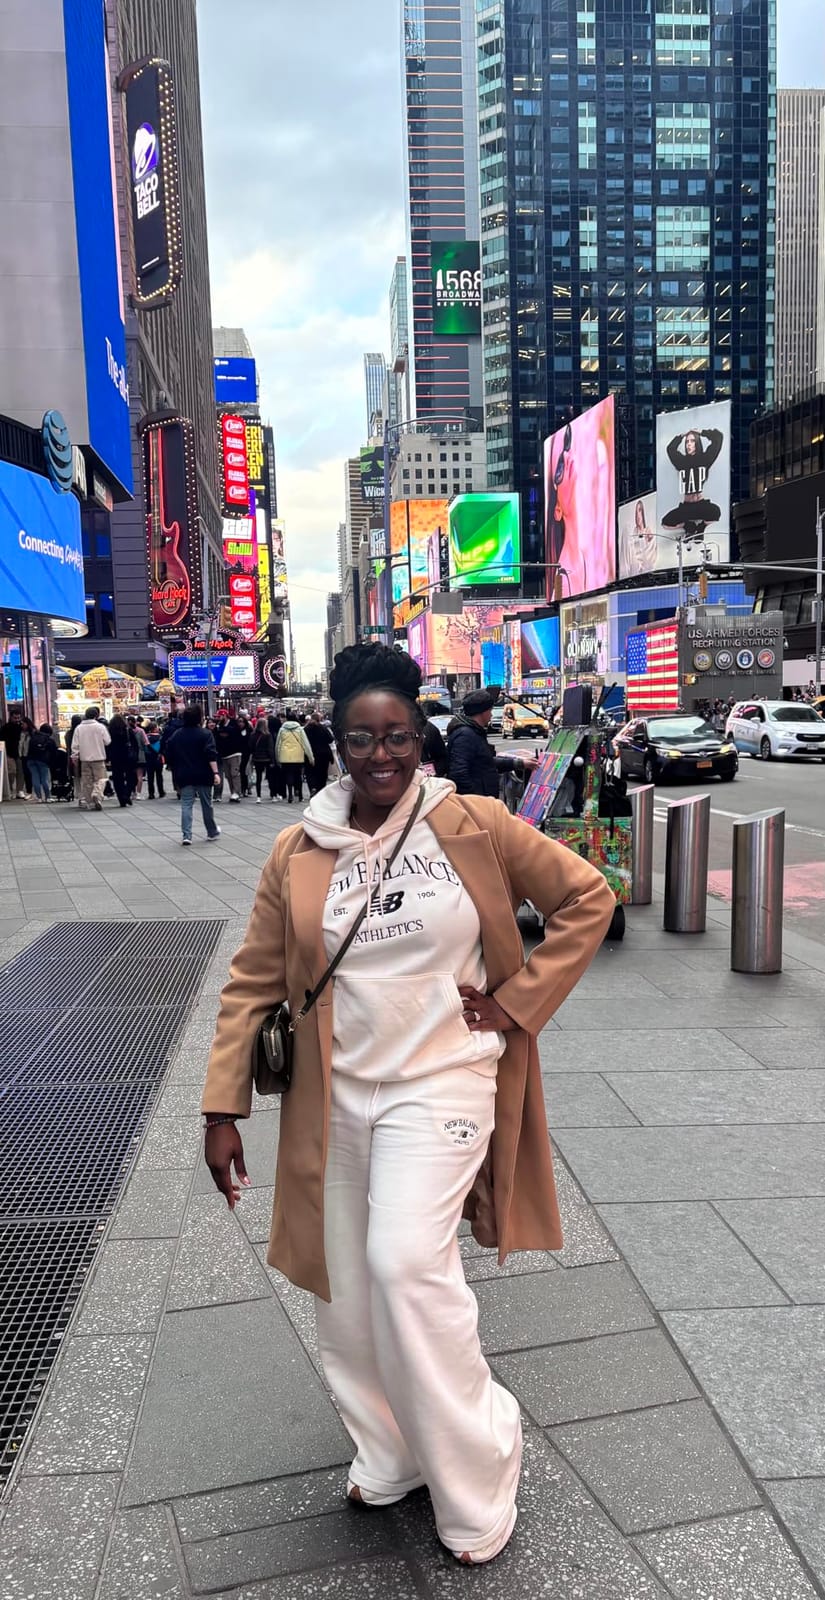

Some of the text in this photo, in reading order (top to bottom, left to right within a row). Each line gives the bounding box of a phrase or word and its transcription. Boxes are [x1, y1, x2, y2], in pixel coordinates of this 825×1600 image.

[134, 172, 158, 202] TACO
[137, 191, 160, 219] BELL
[436, 268, 481, 290] 1568
[436, 290, 481, 298] BROADWA
[105, 336, 119, 388] The
[364, 486, 385, 497] Wick
[679, 466, 706, 494] GAP
[18, 530, 64, 564] Connecting
[152, 585, 187, 600] Hard Rock
[215, 640, 233, 649] Rock
[688, 627, 780, 639] U.S. ARMED FORCES
[692, 637, 776, 648] RECRUITING STATION
[580, 638, 599, 656] NAVY
[326, 853, 460, 901] EW BALANCE
[333, 907, 348, 917] EST.
[417, 891, 436, 900] 1906
[354, 919, 424, 945] ATHLETICS
